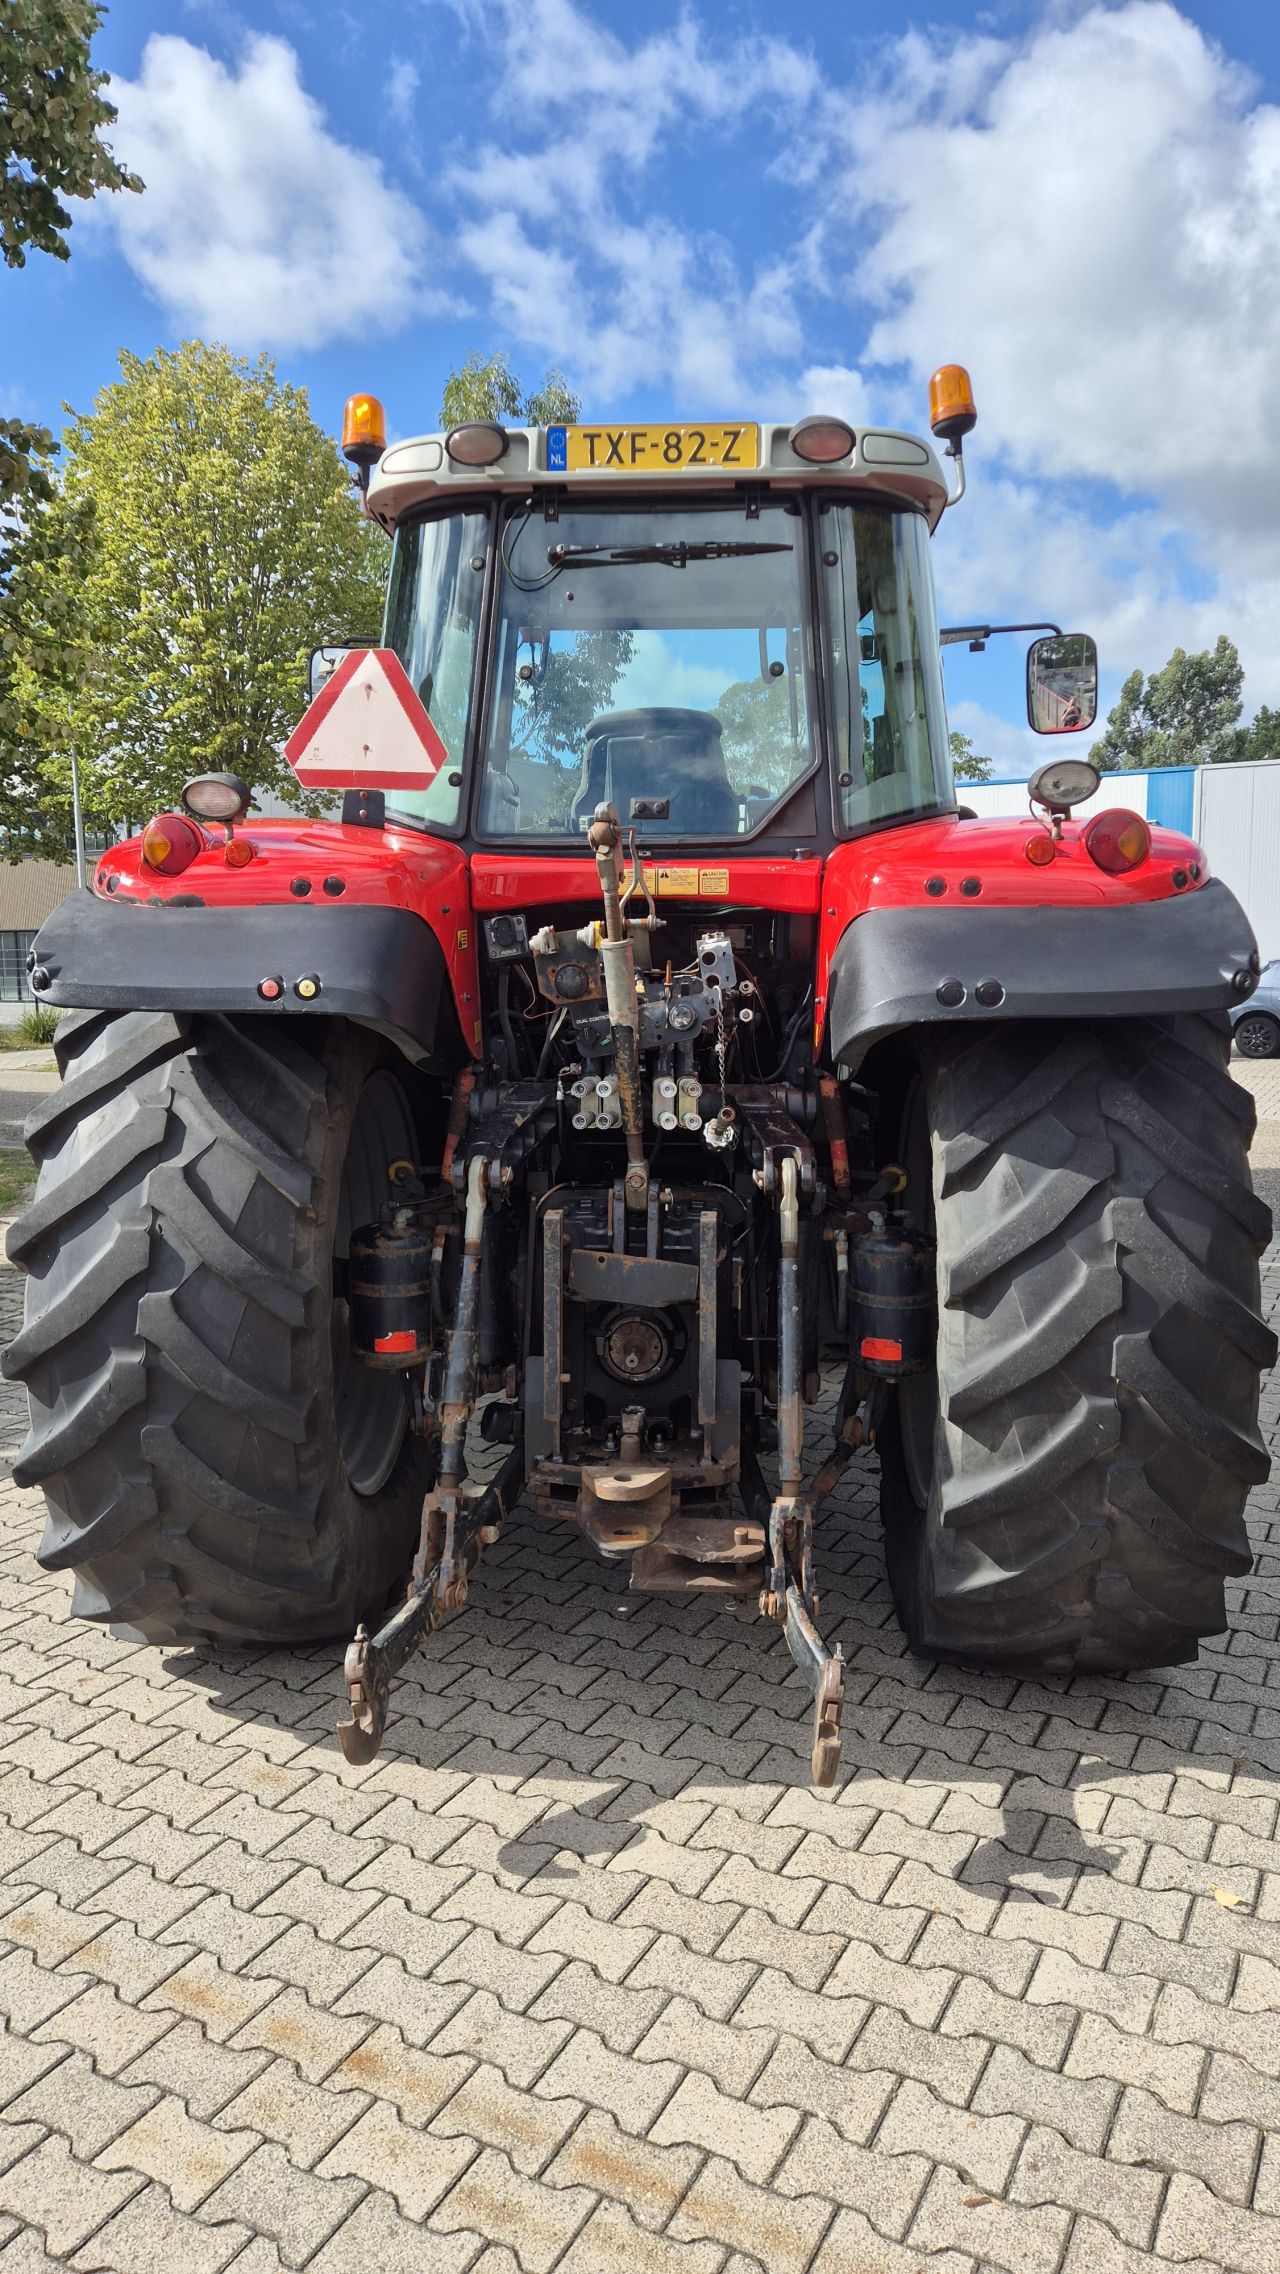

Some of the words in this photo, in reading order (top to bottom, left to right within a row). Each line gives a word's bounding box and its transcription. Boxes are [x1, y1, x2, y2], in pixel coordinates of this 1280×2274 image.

[583, 430, 742, 465] TXF-82-Z
[550, 454, 564, 465] NL
[589, 1014, 609, 1022] CONTRO
